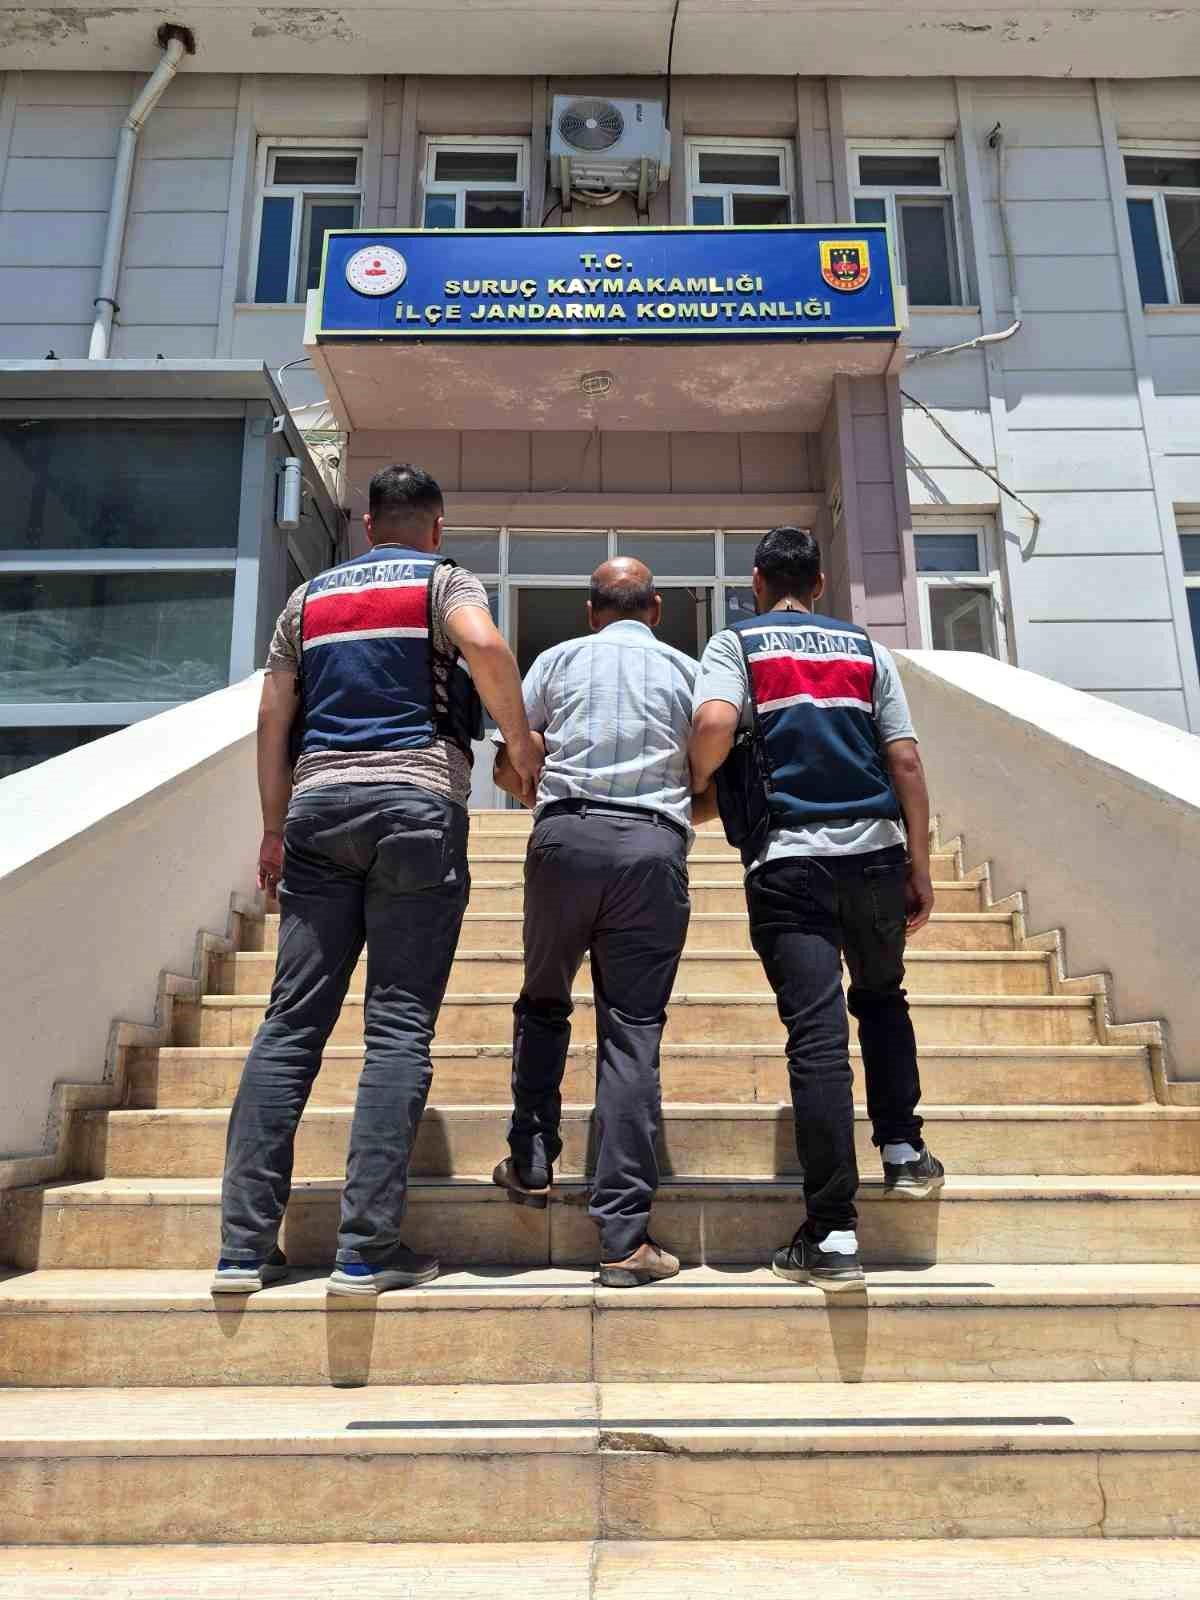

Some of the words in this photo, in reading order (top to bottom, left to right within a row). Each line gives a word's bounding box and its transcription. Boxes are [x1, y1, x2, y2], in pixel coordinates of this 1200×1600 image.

[580, 253, 632, 270] T.C.
[444, 279, 537, 298] SURUÇ
[548, 274, 763, 295] KAYMAKAMLIĞI
[395, 301, 461, 323] İLÇE
[470, 303, 626, 320] JANDARMA
[637, 298, 831, 319] KOMUTANLIĞI
[318, 563, 416, 591] JANDARMA
[759, 631, 861, 655] JANDARMA
